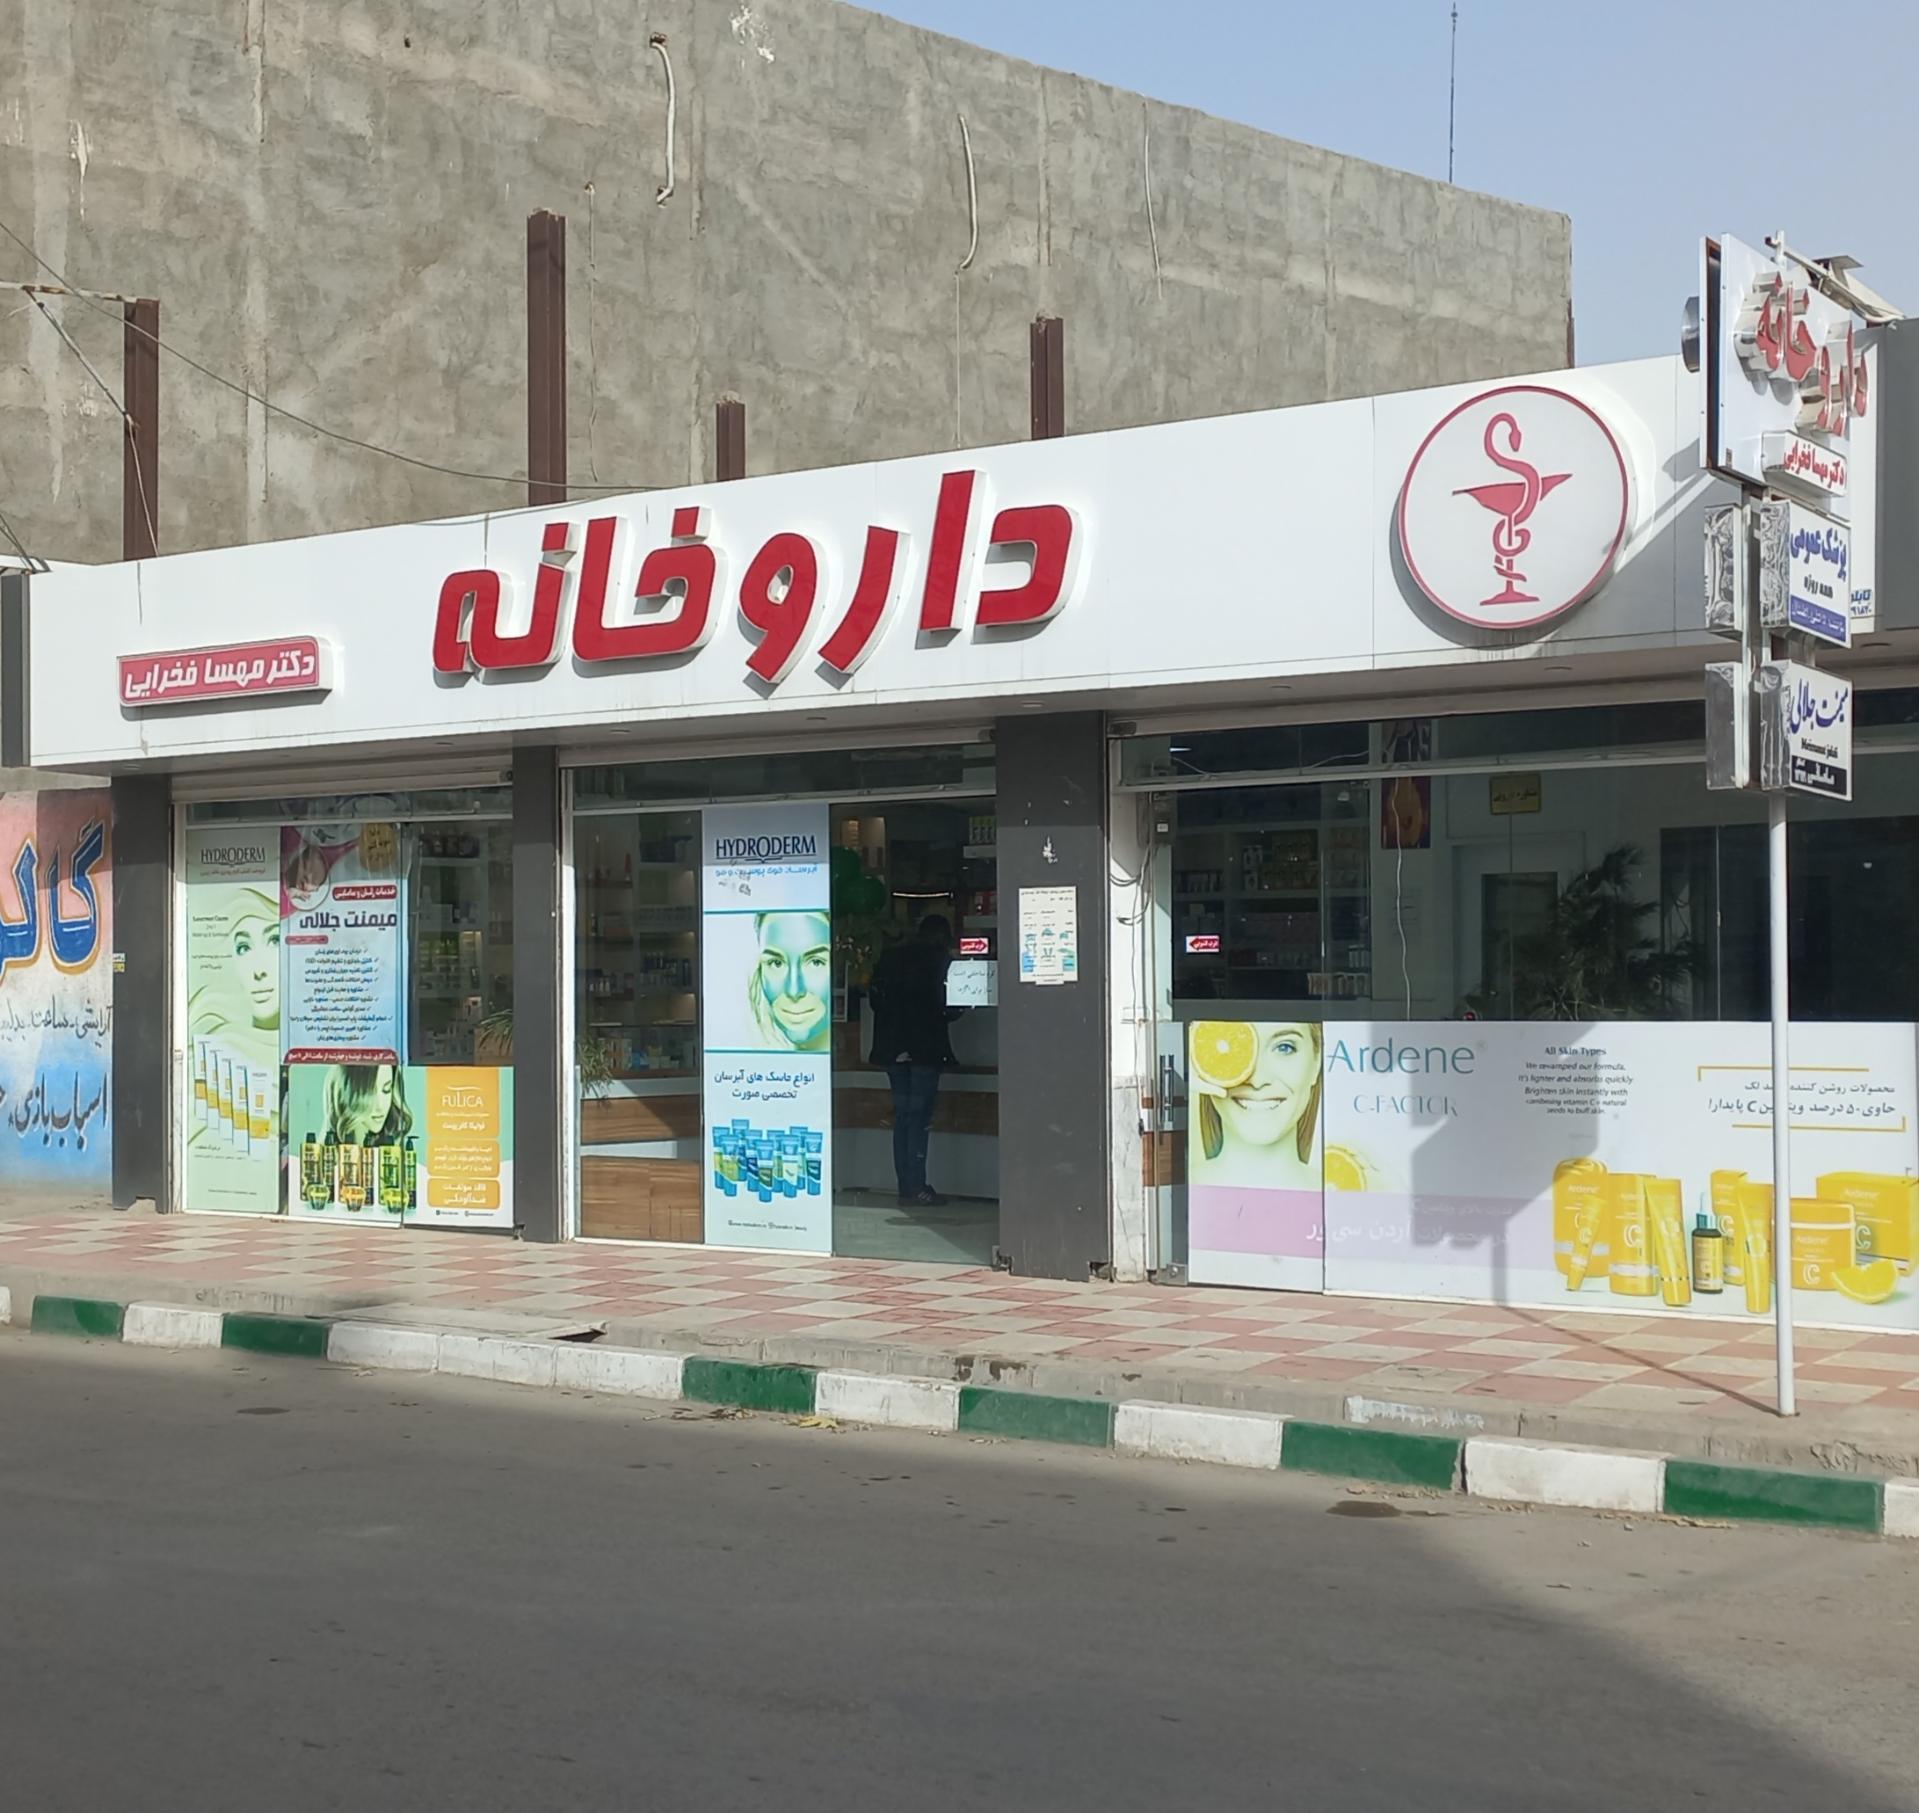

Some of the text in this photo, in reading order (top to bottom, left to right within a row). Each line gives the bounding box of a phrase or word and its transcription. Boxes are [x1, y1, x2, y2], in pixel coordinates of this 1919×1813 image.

[1755, 270, 1869, 438] داروخانه
[1812, 447, 1828, 483] مهسا
[1828, 460, 1845, 488] دکتر
[1790, 527, 1847, 582] پزشک عمومی
[433, 470, 1076, 685] داروخانه
[124, 649, 316, 699] دکتر مهسا فخرایی
[716, 835, 817, 858] HYDRODERM
[201, 847, 266, 864] HYDRODERM
[299, 911, 397, 932] میمنت جلالی
[1327, 1037, 1475, 1074] Ardene
[1544, 1045, 1607, 1057] All Skin Types
[1525, 1061, 1538, 1070] We
[1539, 1061, 1577, 1072] revamped
[1578, 1063, 1592, 1071] our
[713, 1069, 815, 1088] انواع ماسک های آبرسان
[1530, 1074, 1555, 1084] lighter
[1557, 1074, 1572, 1083] and
[1573, 1074, 1603, 1083] absorbs
[1605, 1075, 1634, 1085] quickly
[1744, 1081, 1760, 1091] لک
[731, 1088, 798, 1101] تخصصی صورت
[1524, 1086, 1629, 1097] Brighten skin instantly with
[1789, 1082, 1817, 1092] کننده
[1818, 1083, 1847, 1095] روشن
[1849, 1082, 1896, 1096] محصولات
[442, 1091, 484, 1108] FULICA
[1563, 1098, 1588, 1106] vitamin
[1602, 1098, 1627, 1107] natural
[51, 1071, 107, 1150] اسباب
[1567, 1107, 1575, 1115] to
[1575, 1107, 1590, 1115] buff
[1809, 1101, 1845, 1116] درصد
[1861, 1101, 1896, 1117] حاوی
